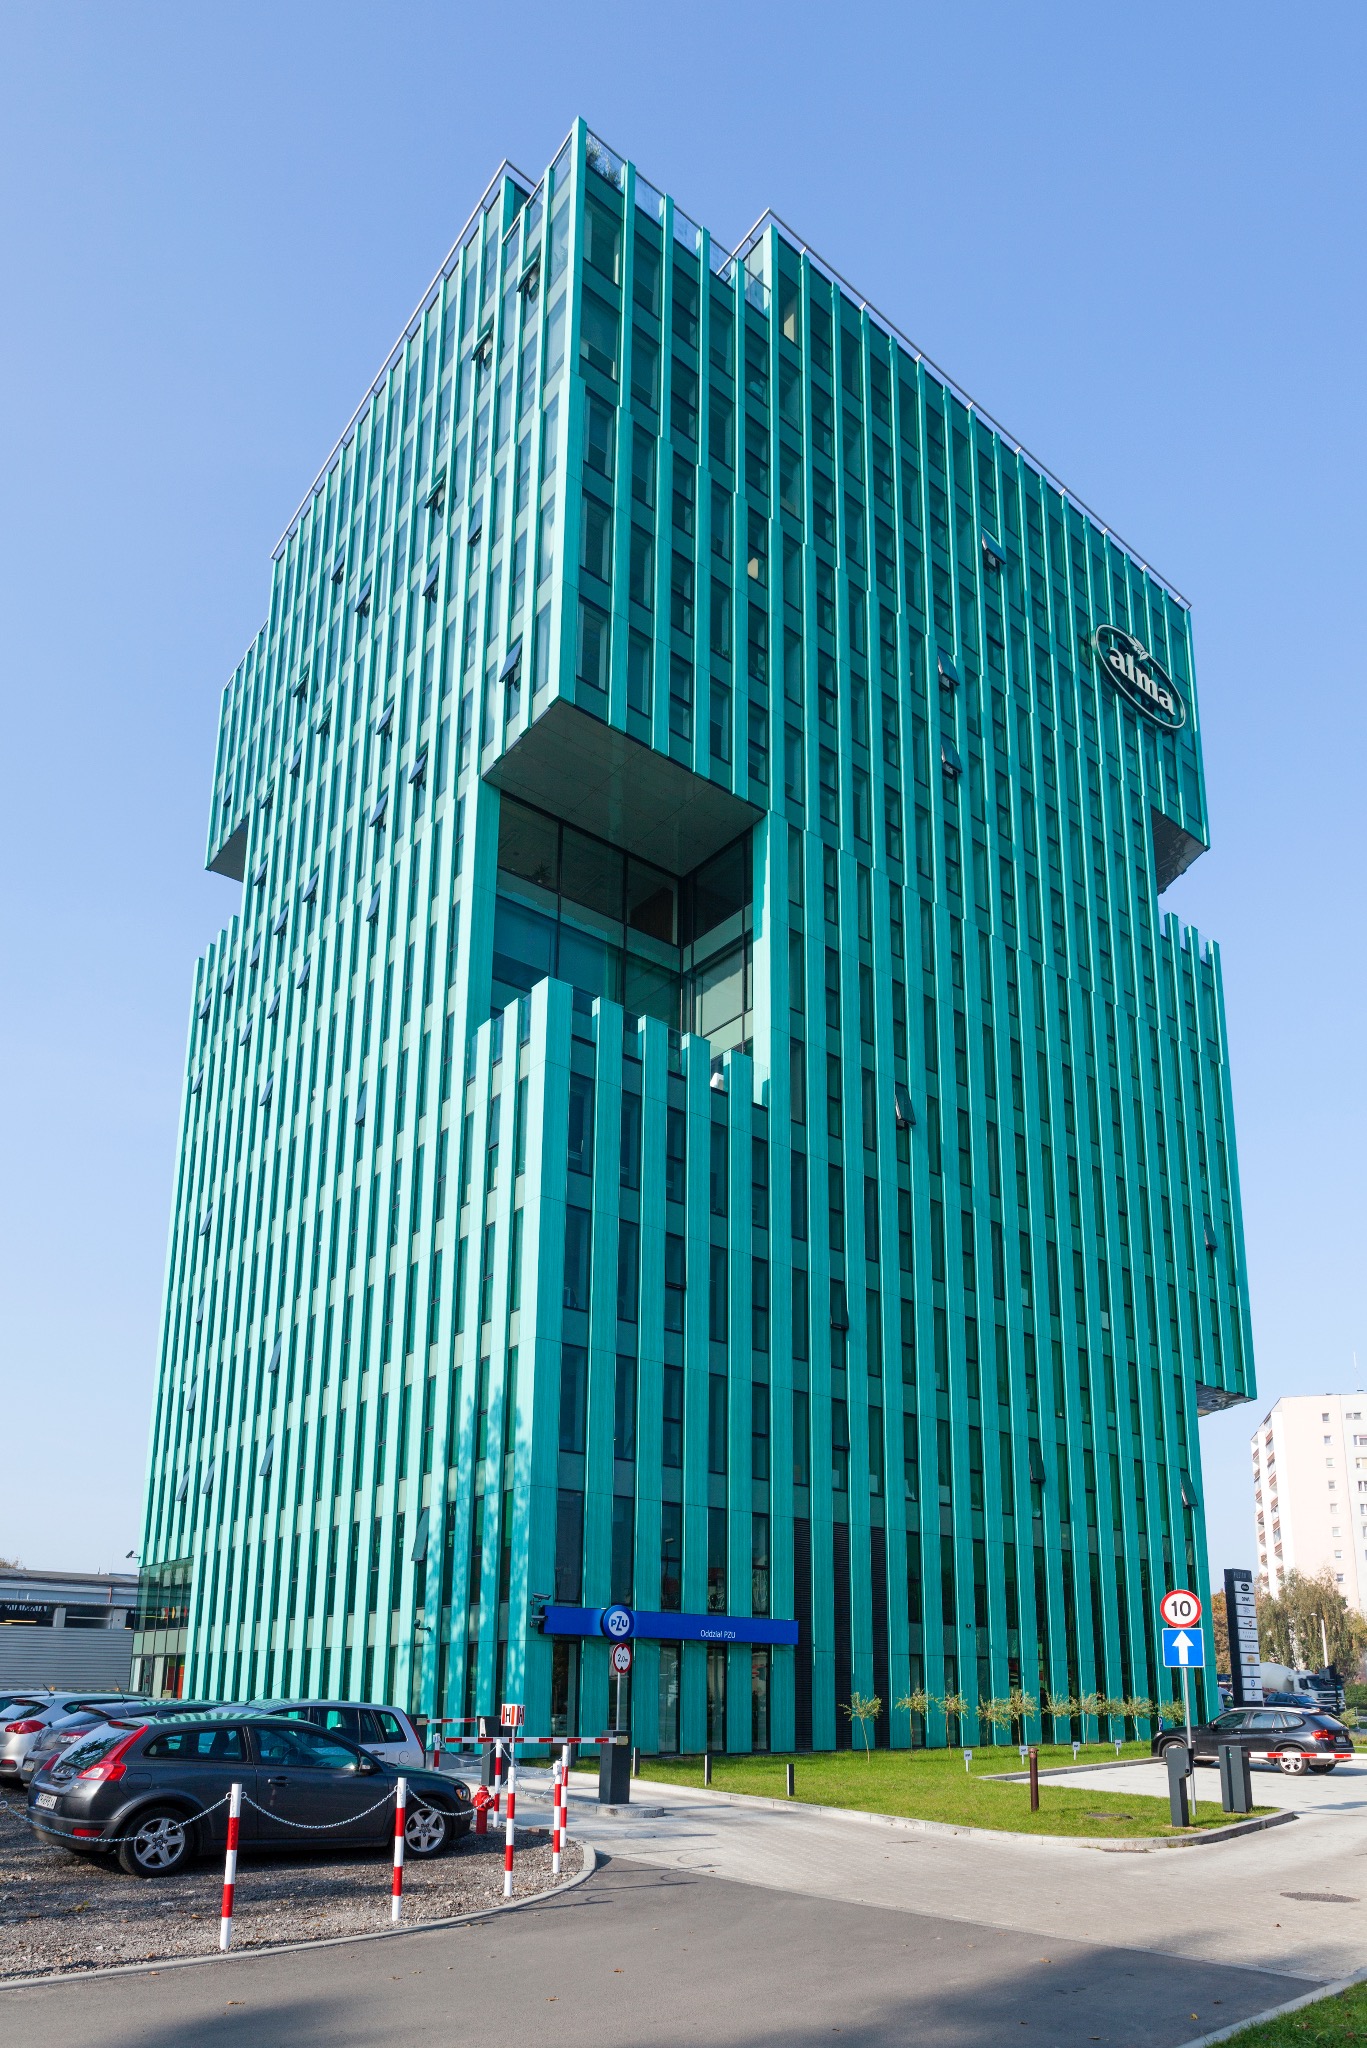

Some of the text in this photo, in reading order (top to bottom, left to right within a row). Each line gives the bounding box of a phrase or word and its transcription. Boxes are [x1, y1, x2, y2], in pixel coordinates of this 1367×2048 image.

[1109, 647, 1176, 716] alma
[1171, 1600, 1191, 1617] 10
[611, 1616, 628, 1631] PZU
[723, 1630, 736, 1639] PZU
